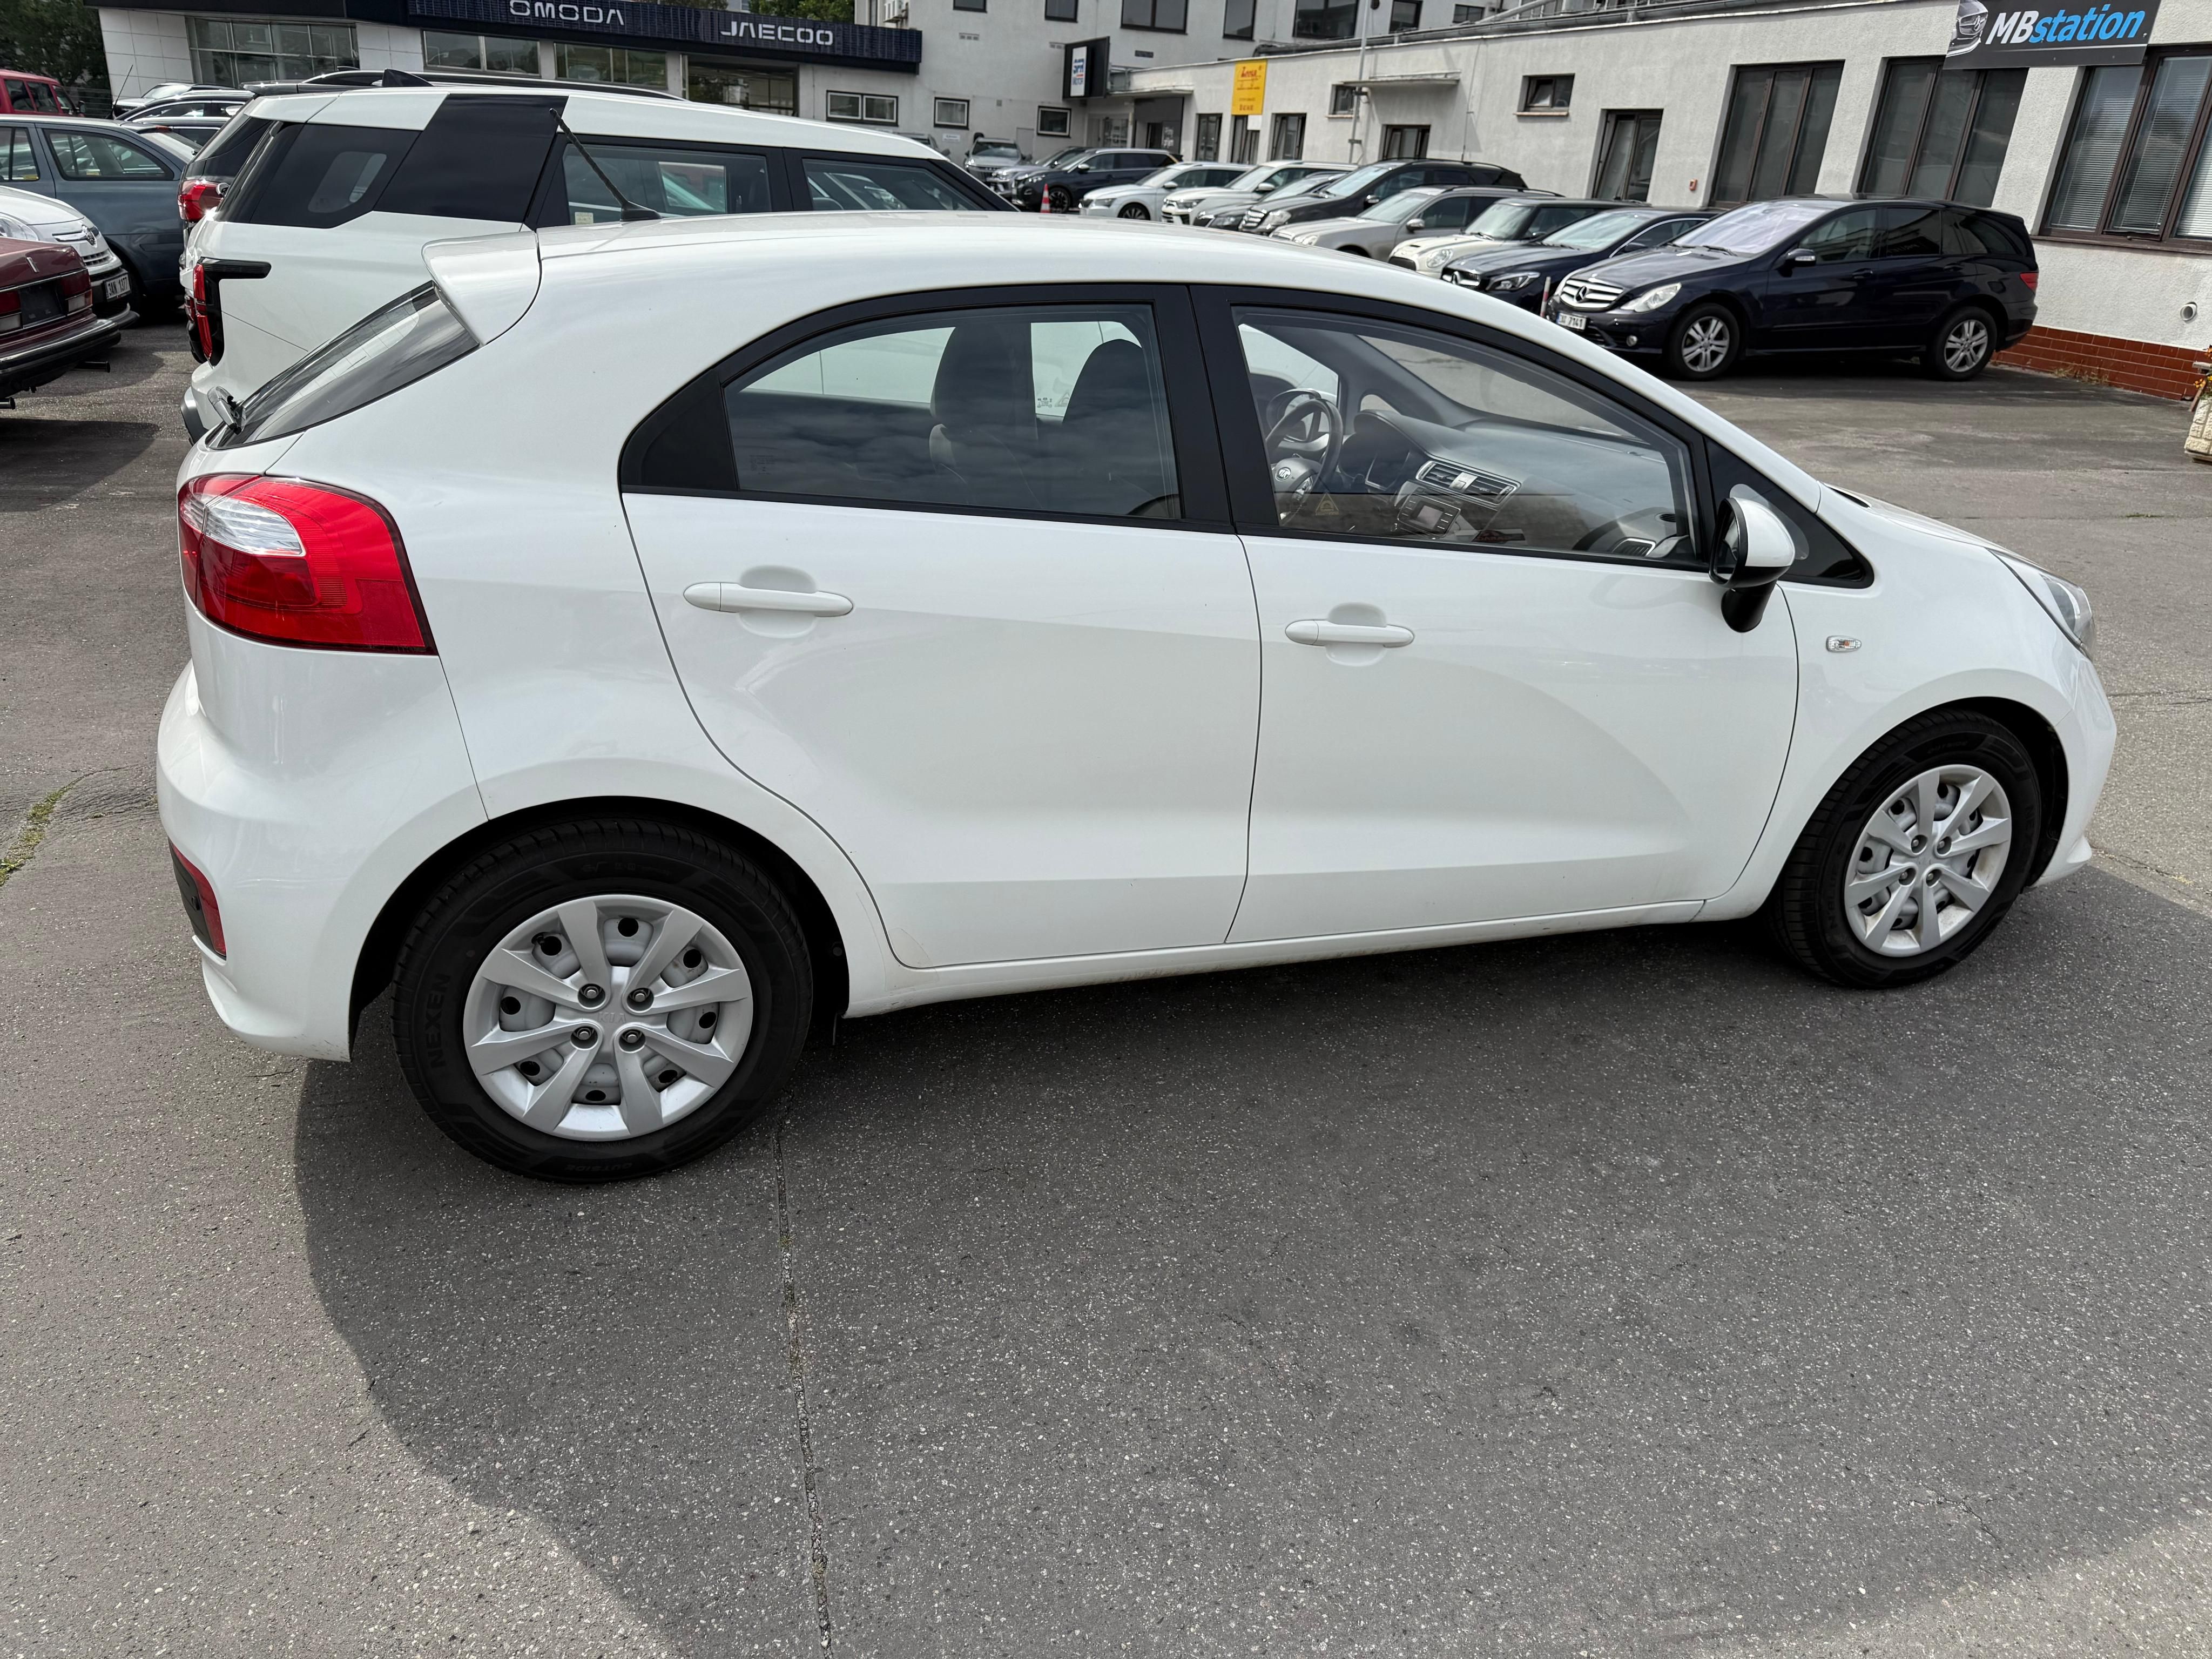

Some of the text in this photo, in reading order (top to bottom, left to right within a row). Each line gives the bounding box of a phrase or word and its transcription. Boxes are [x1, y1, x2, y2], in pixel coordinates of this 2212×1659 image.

[510, 0, 624, 25] OMODA
[1985, 4, 2146, 45] MBstation
[720, 21, 833, 45] JAECOO
[424, 973, 450, 1068] NEXEN
